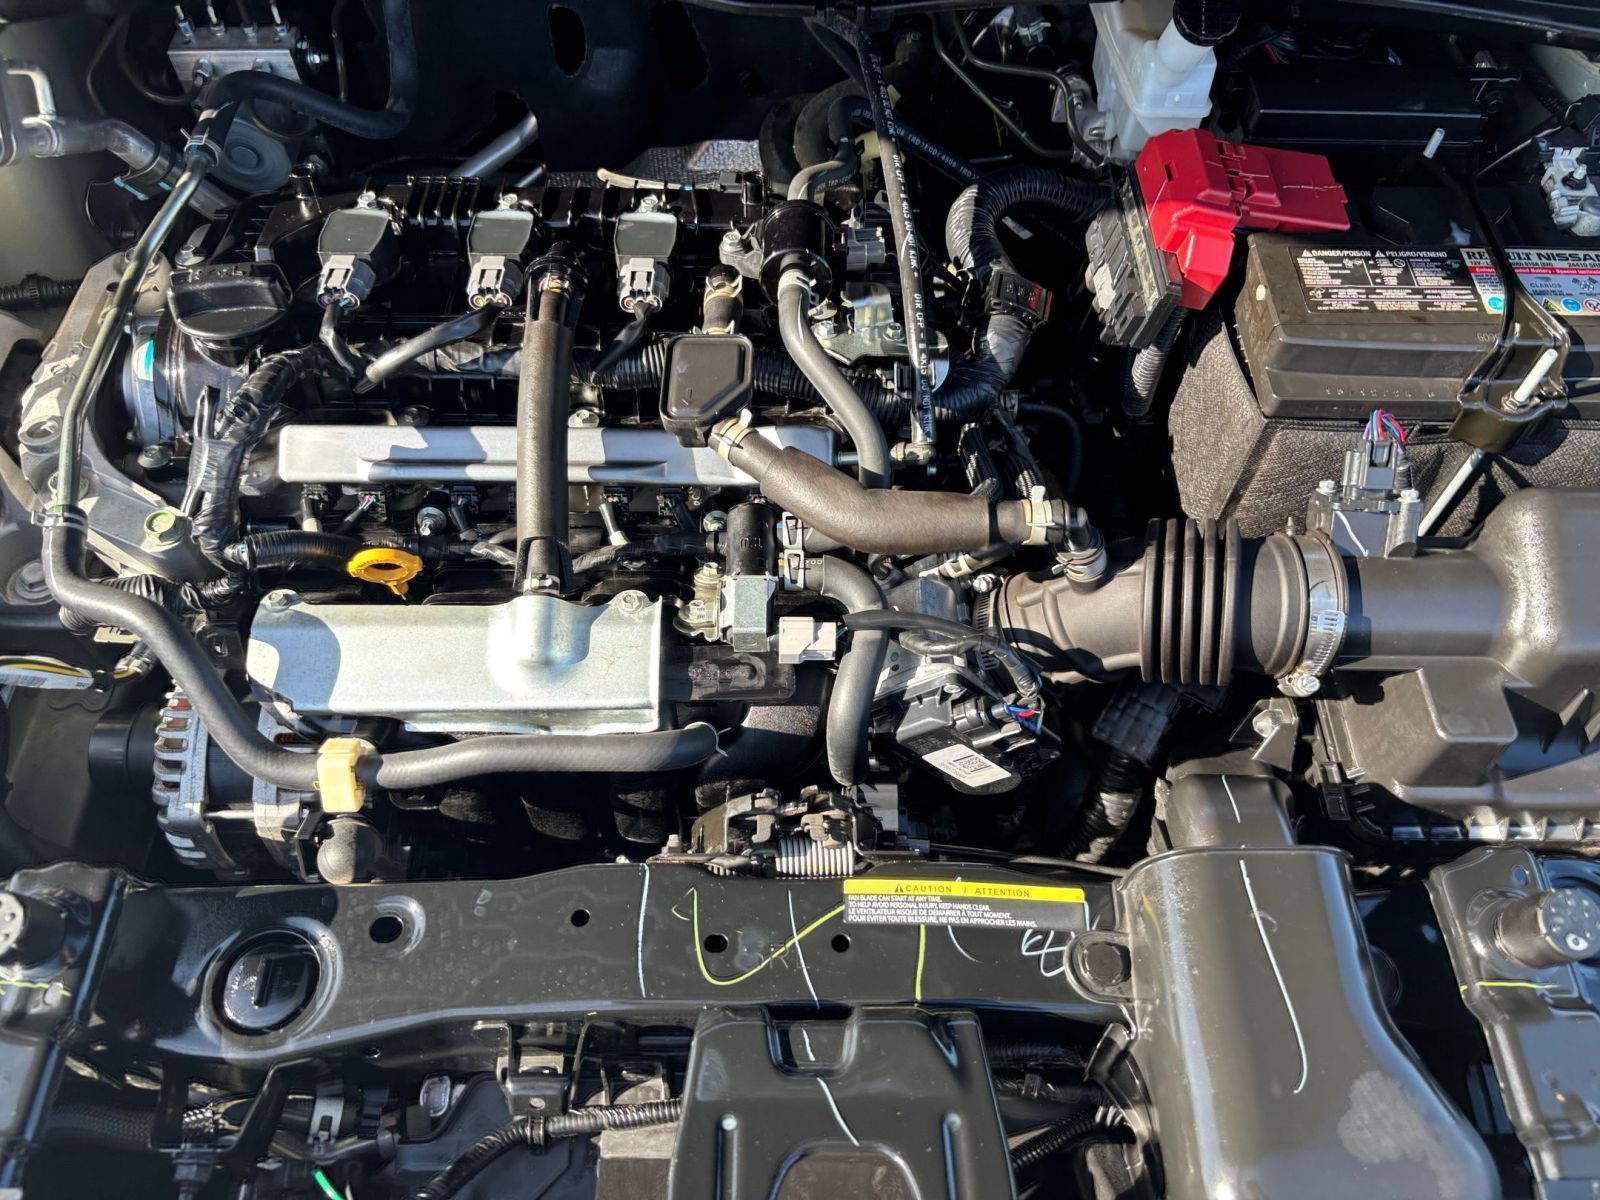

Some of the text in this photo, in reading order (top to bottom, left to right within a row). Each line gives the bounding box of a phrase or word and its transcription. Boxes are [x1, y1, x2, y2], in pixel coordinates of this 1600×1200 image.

[1312, 250, 1371, 258] DANGER/POISON
[1466, 251, 1531, 261] REULT
[905, 884, 952, 893] CAUTION
[975, 887, 1030, 897] ATTENTION
